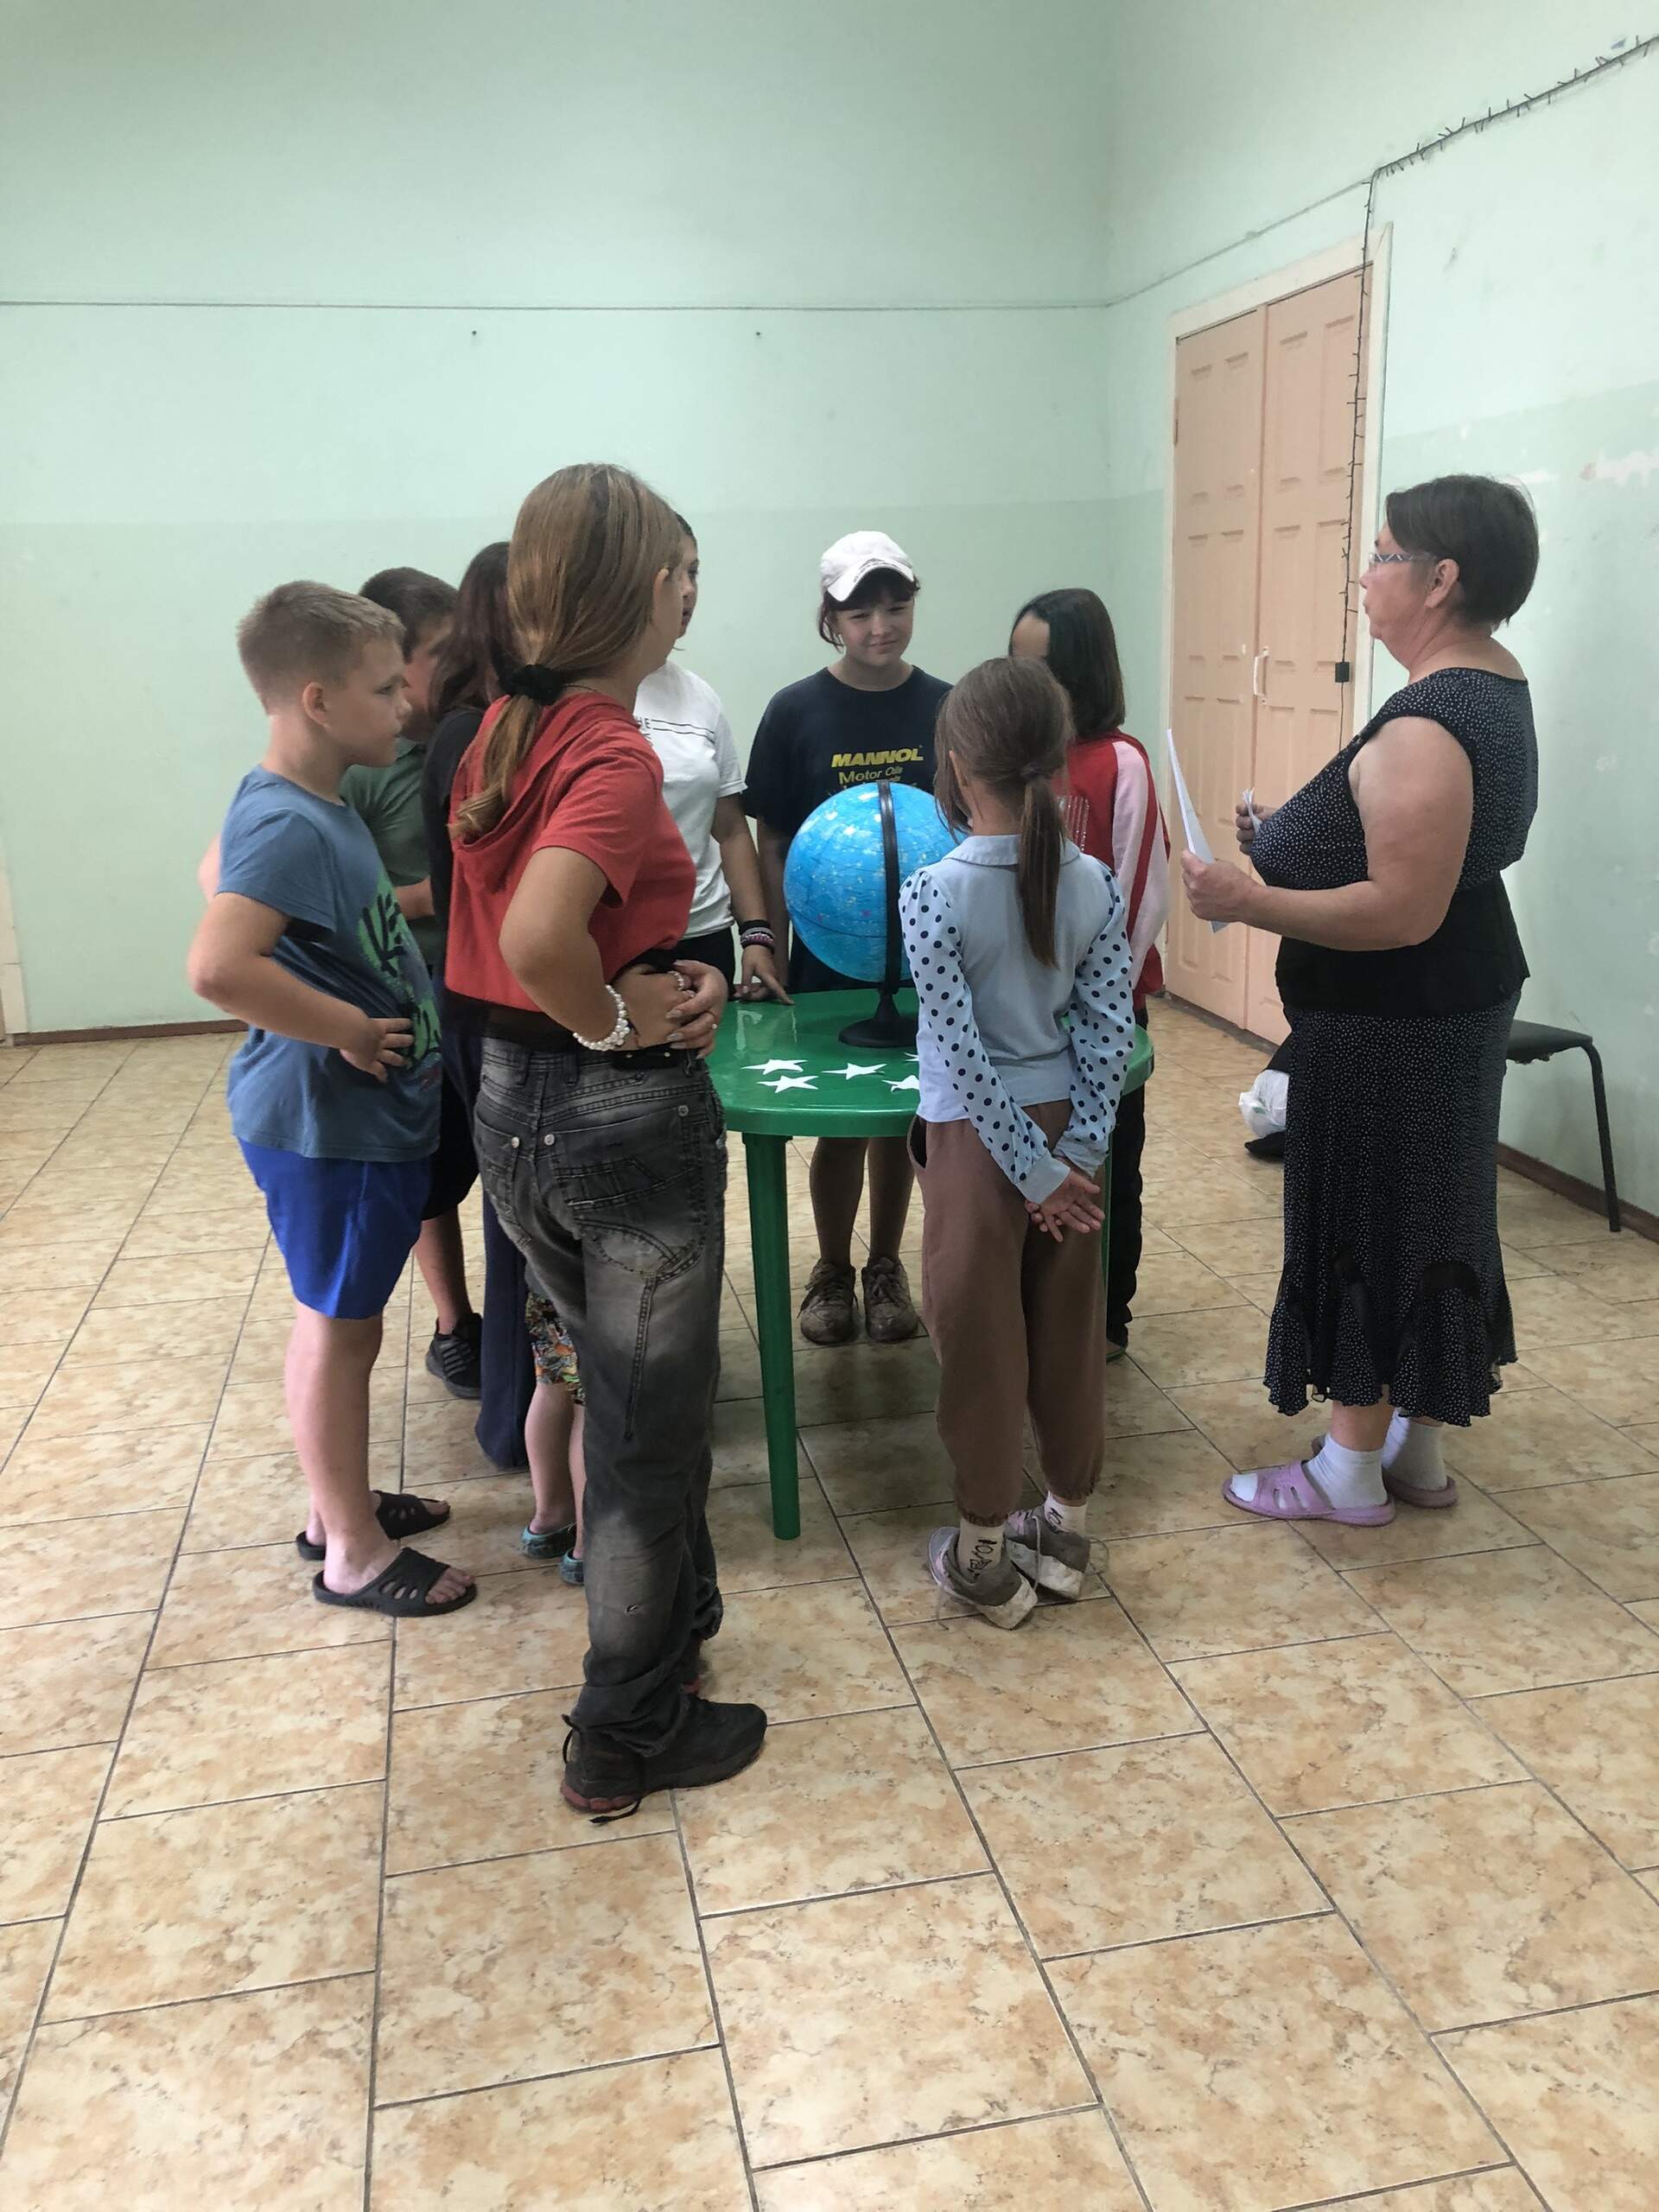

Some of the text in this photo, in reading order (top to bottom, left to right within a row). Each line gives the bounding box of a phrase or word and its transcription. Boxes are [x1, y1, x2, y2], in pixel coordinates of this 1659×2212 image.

[831, 748, 924, 767] MANNOL
[838, 770, 882, 785] Motor
[885, 766, 904, 777] Oils
